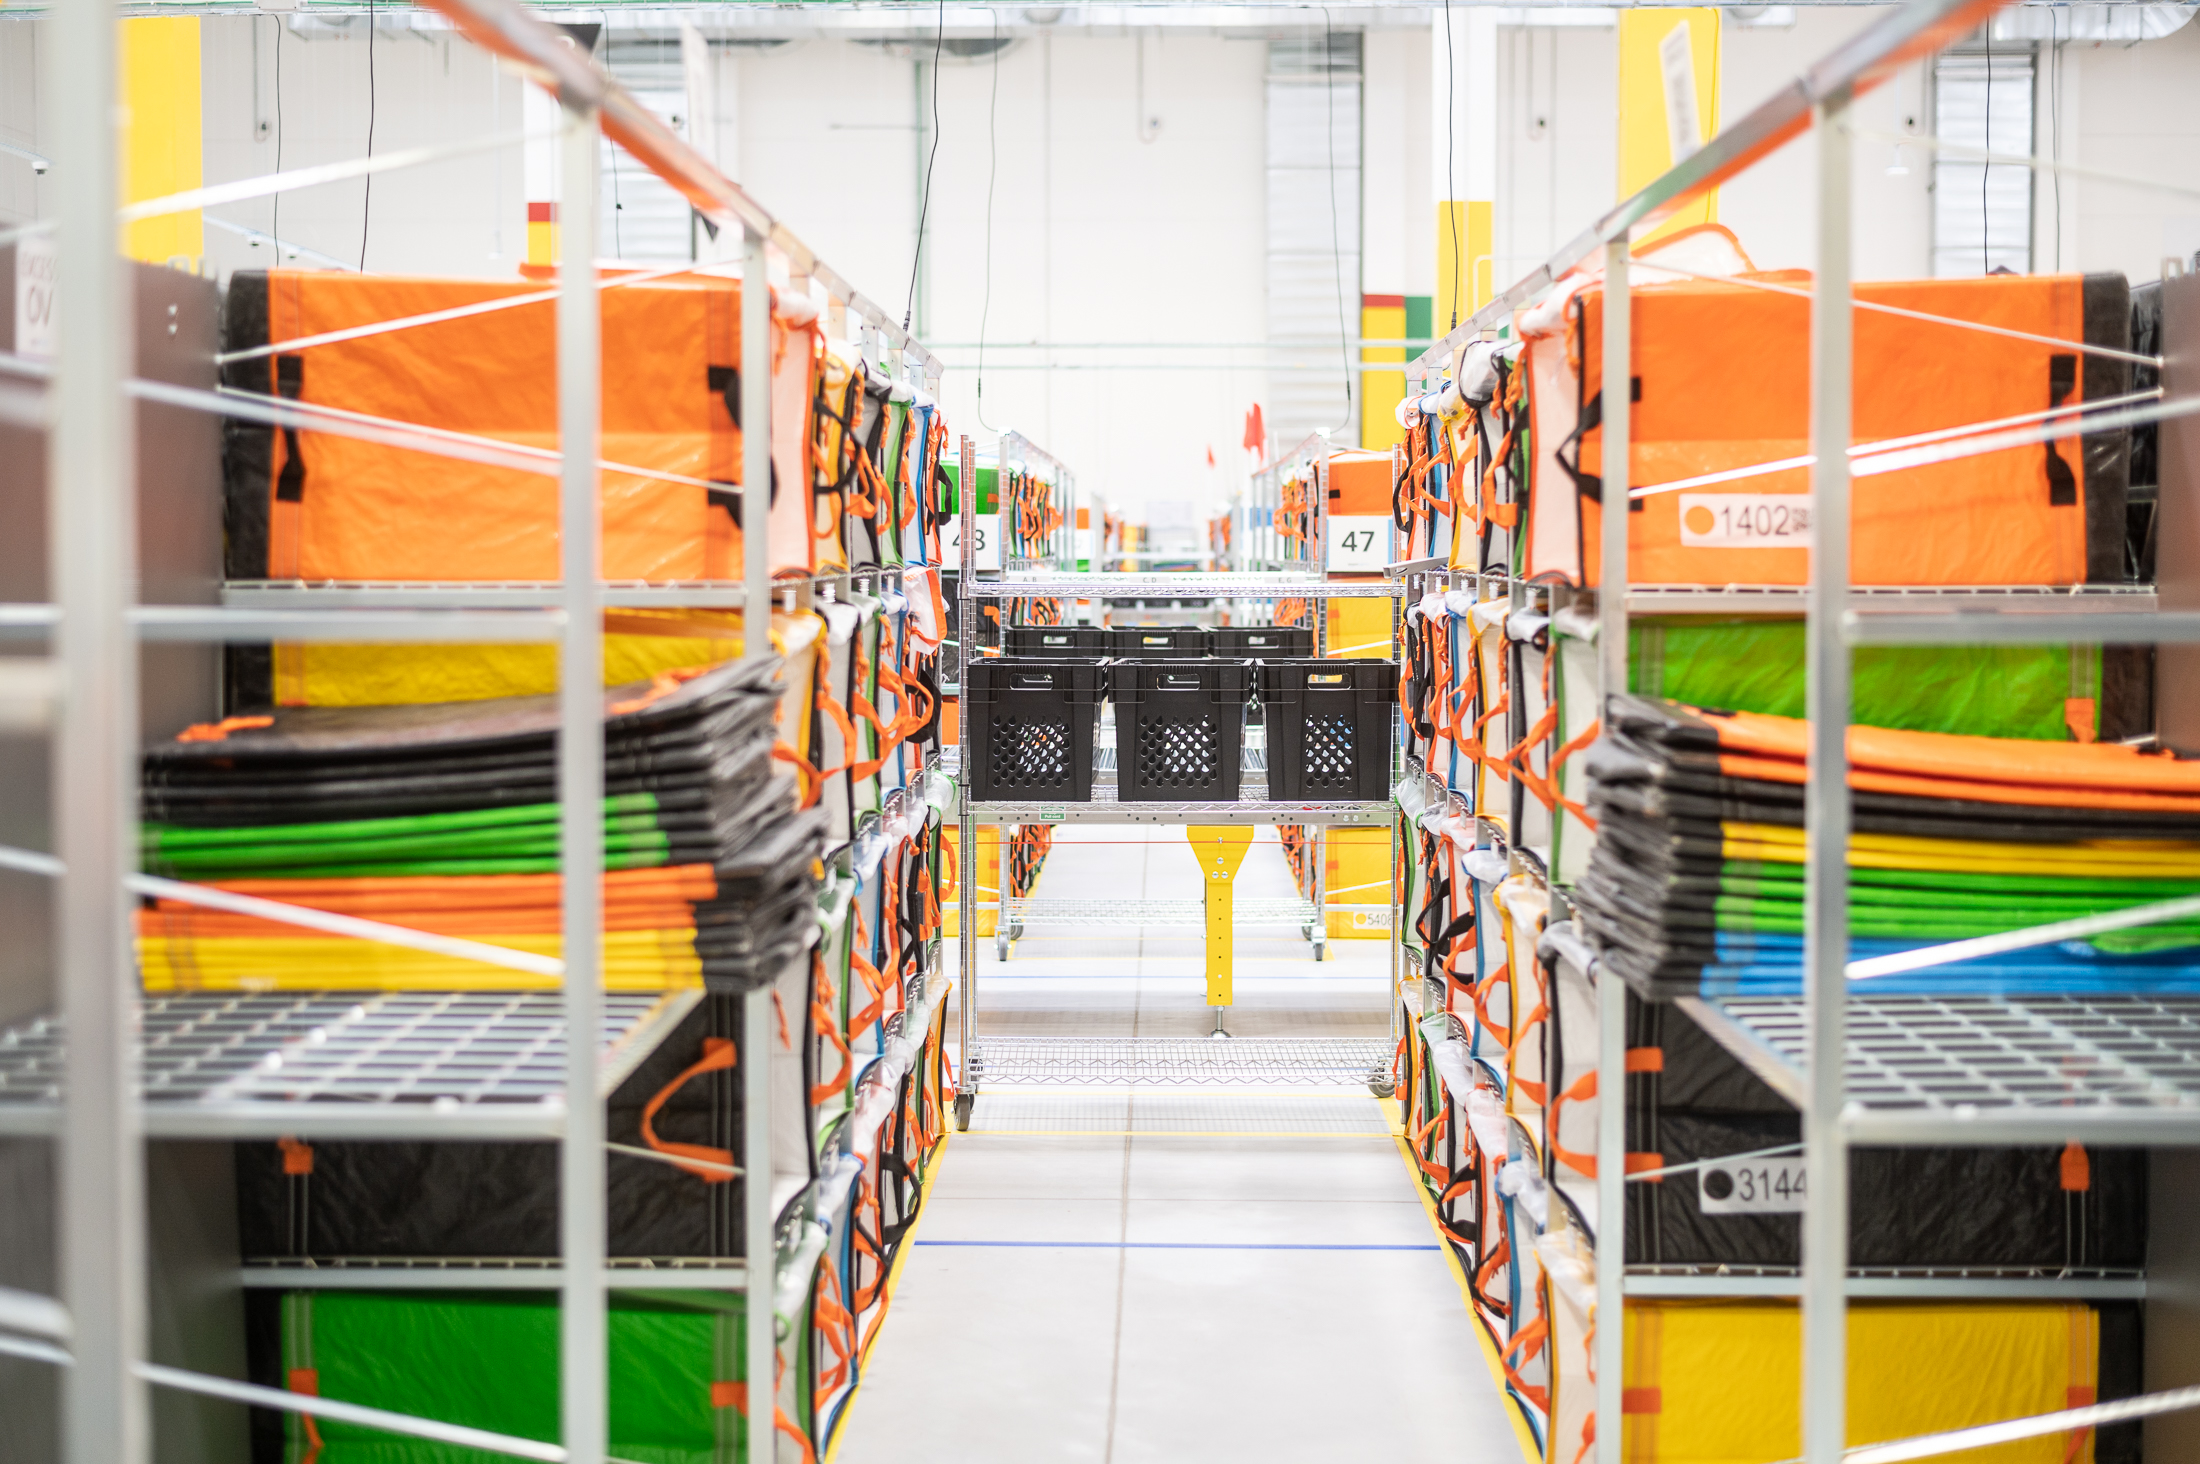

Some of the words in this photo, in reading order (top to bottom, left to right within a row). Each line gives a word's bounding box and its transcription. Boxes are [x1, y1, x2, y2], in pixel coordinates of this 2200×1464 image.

[1720, 505, 1789, 536] 1402
[1341, 531, 1375, 552] 47
[1738, 1168, 1808, 1202] 3144
